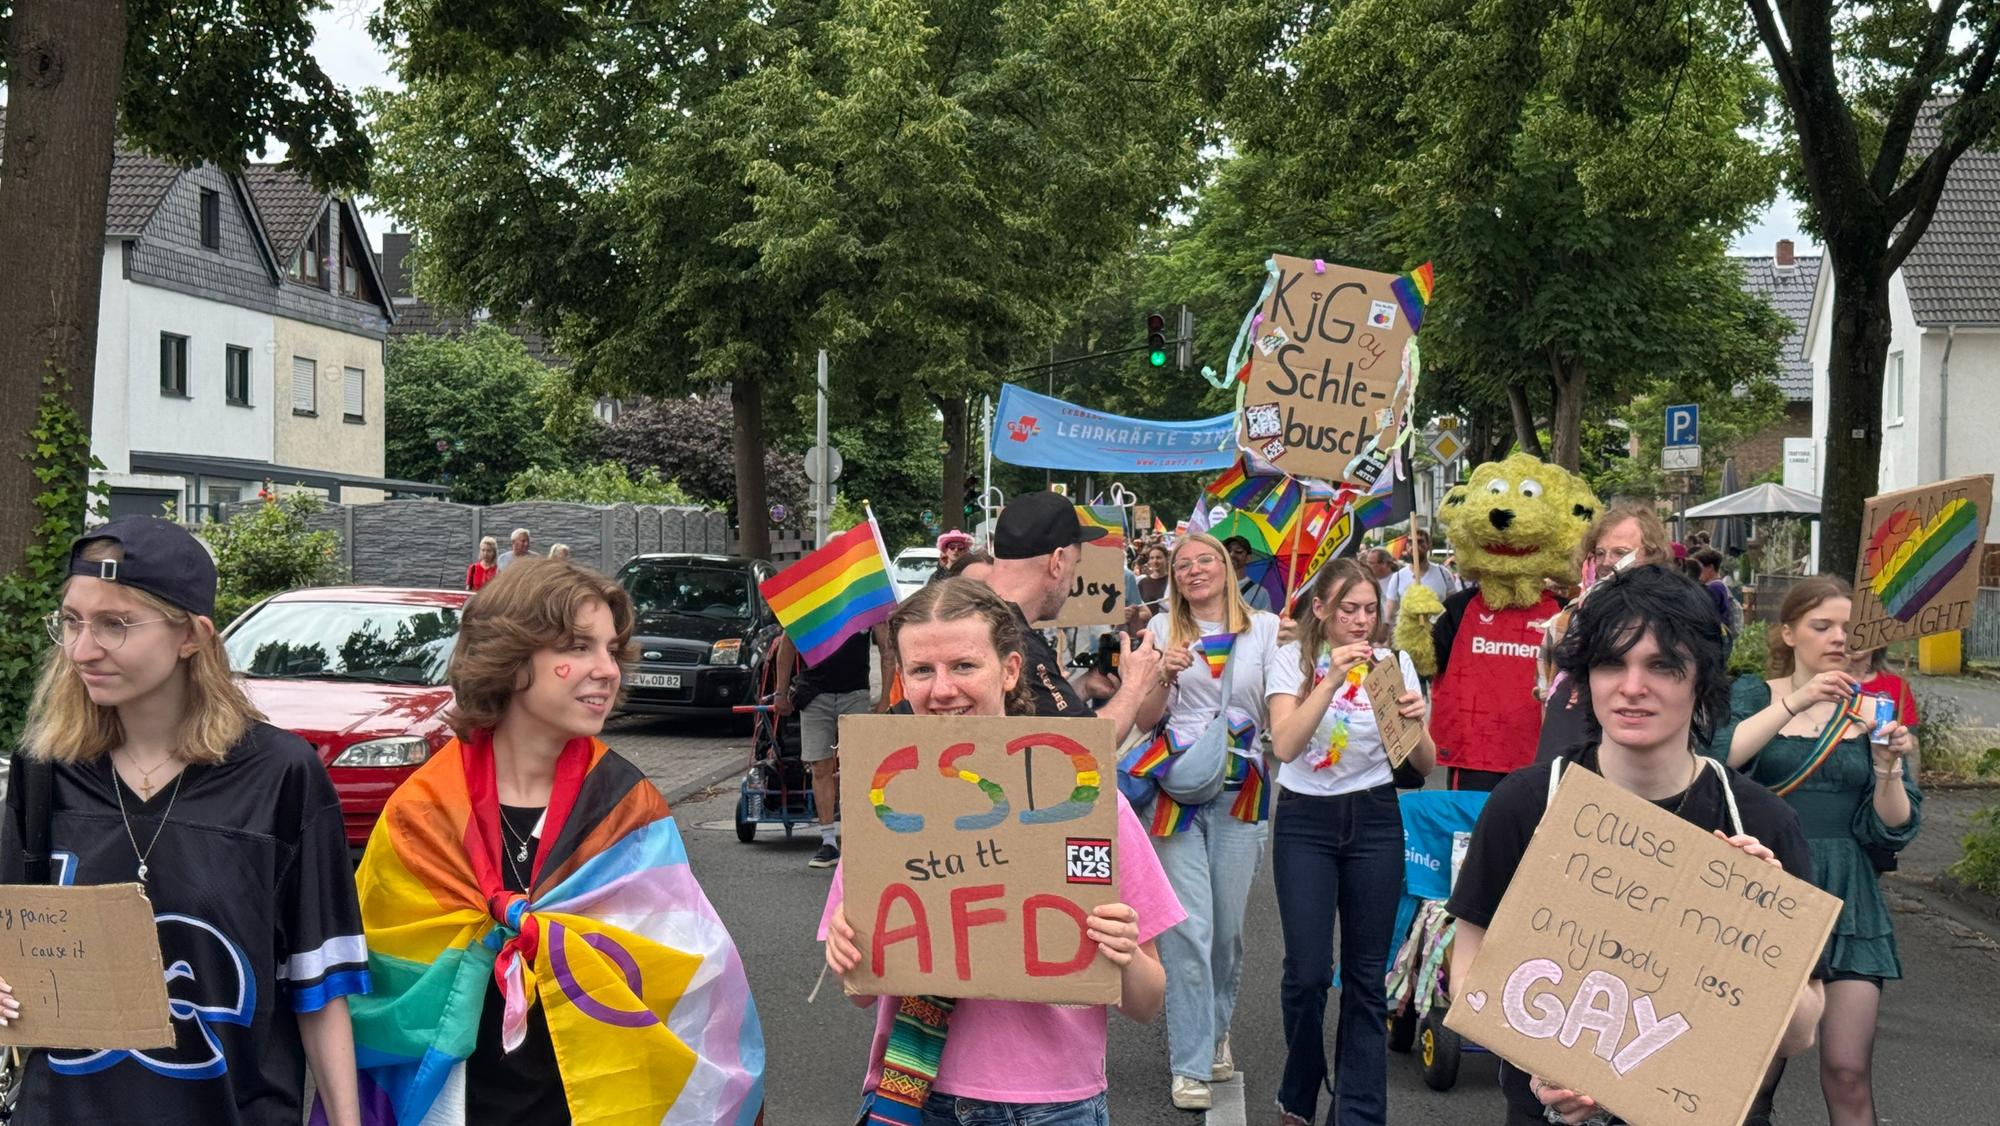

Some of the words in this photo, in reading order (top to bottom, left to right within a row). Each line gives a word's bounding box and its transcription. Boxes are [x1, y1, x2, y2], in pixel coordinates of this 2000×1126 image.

[1265, 344, 1387, 407] Schle-
[1057, 421, 1177, 446] LEHRKRÄFTE
[1673, 411, 1691, 441] P
[1867, 508, 1878, 540] I
[667, 676, 679, 687] 82
[869, 732, 1100, 833] CSD
[1067, 845, 1111, 862] FCK
[1067, 861, 1111, 878] NZS
[20, 907, 68, 933] panic?
[1565, 852, 1669, 913] never
[1679, 908, 1783, 969] made
[871, 882, 1100, 981] AFD
[31, 945, 67, 959] cause
[73, 939, 86, 959] it
[1531, 907, 1669, 994] anybody
[1694, 965, 1744, 1007] less
[1501, 957, 1692, 1077] GAY
